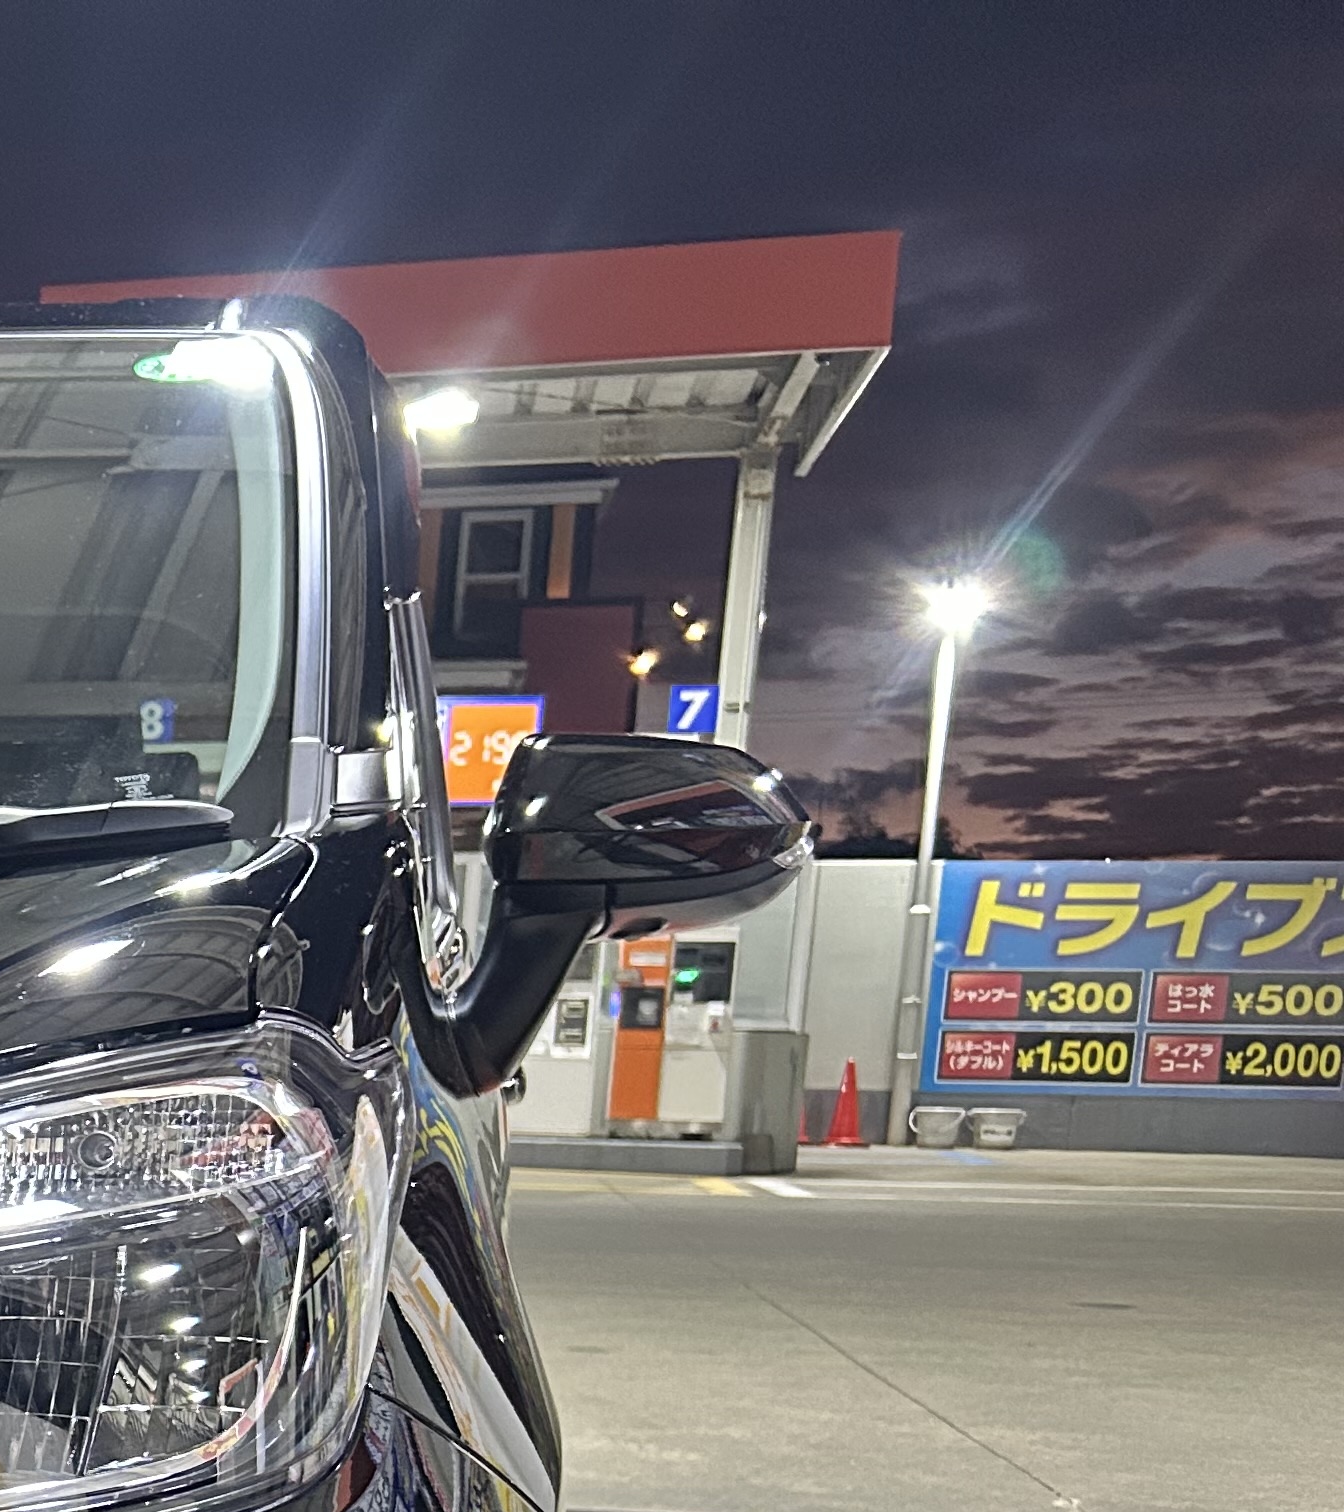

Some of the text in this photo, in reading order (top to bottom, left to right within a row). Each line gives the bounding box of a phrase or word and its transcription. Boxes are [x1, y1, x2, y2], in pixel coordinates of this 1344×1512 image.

[677, 689, 710, 730] 7
[952, 988, 1019, 1003] シャンプー
[1025, 981, 1134, 1014] ¥300
[1167, 983, 1216, 998] はっ水
[1232, 984, 1343, 1016] ¥500
[1167, 999, 1213, 1014] コート
[1016, 1040, 1128, 1076] ¥1,500
[1154, 1042, 1215, 1058] ティアラ
[1225, 1041, 1342, 1079] ¥2,000
[1159, 1059, 1206, 1074] コート
